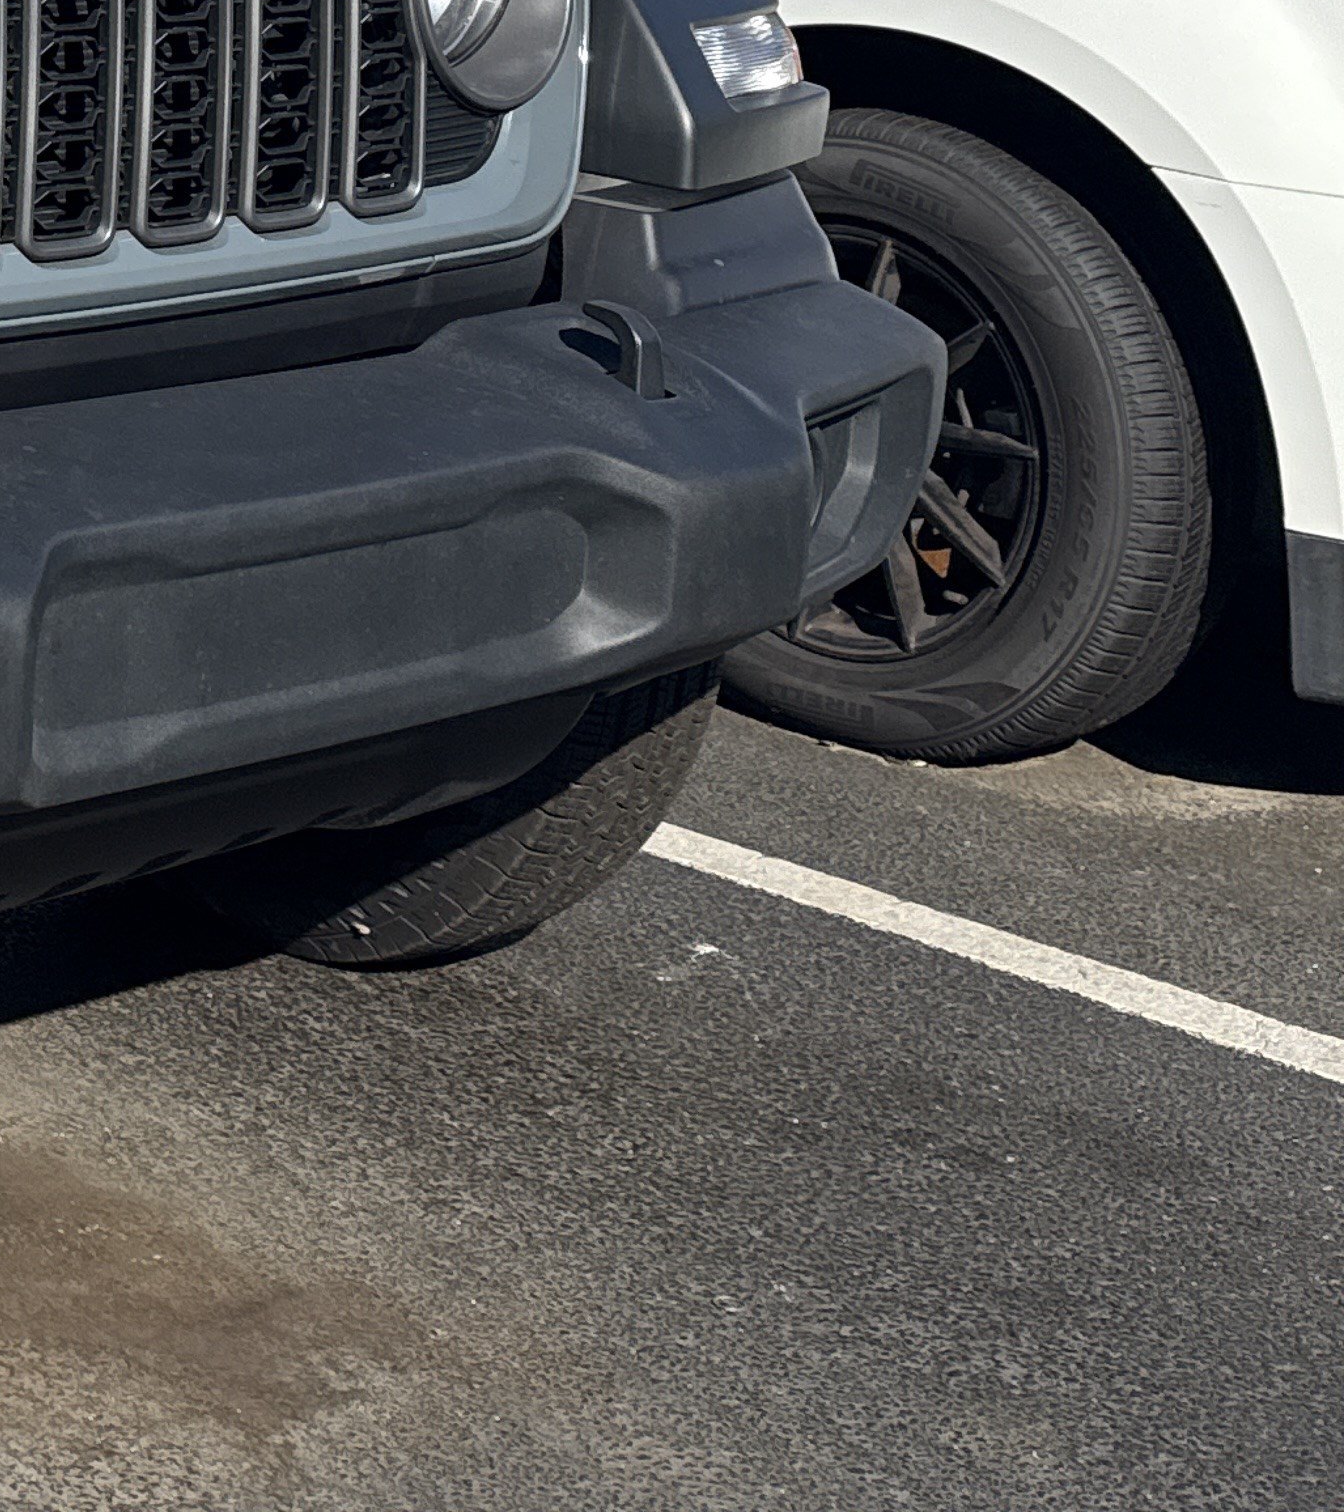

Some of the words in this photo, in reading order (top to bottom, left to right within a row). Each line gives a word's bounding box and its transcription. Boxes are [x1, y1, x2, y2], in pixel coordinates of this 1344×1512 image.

[849, 158, 964, 228] PIRELLI
[1067, 395, 1099, 563] 225/65
[1040, 565, 1079, 643] R17
